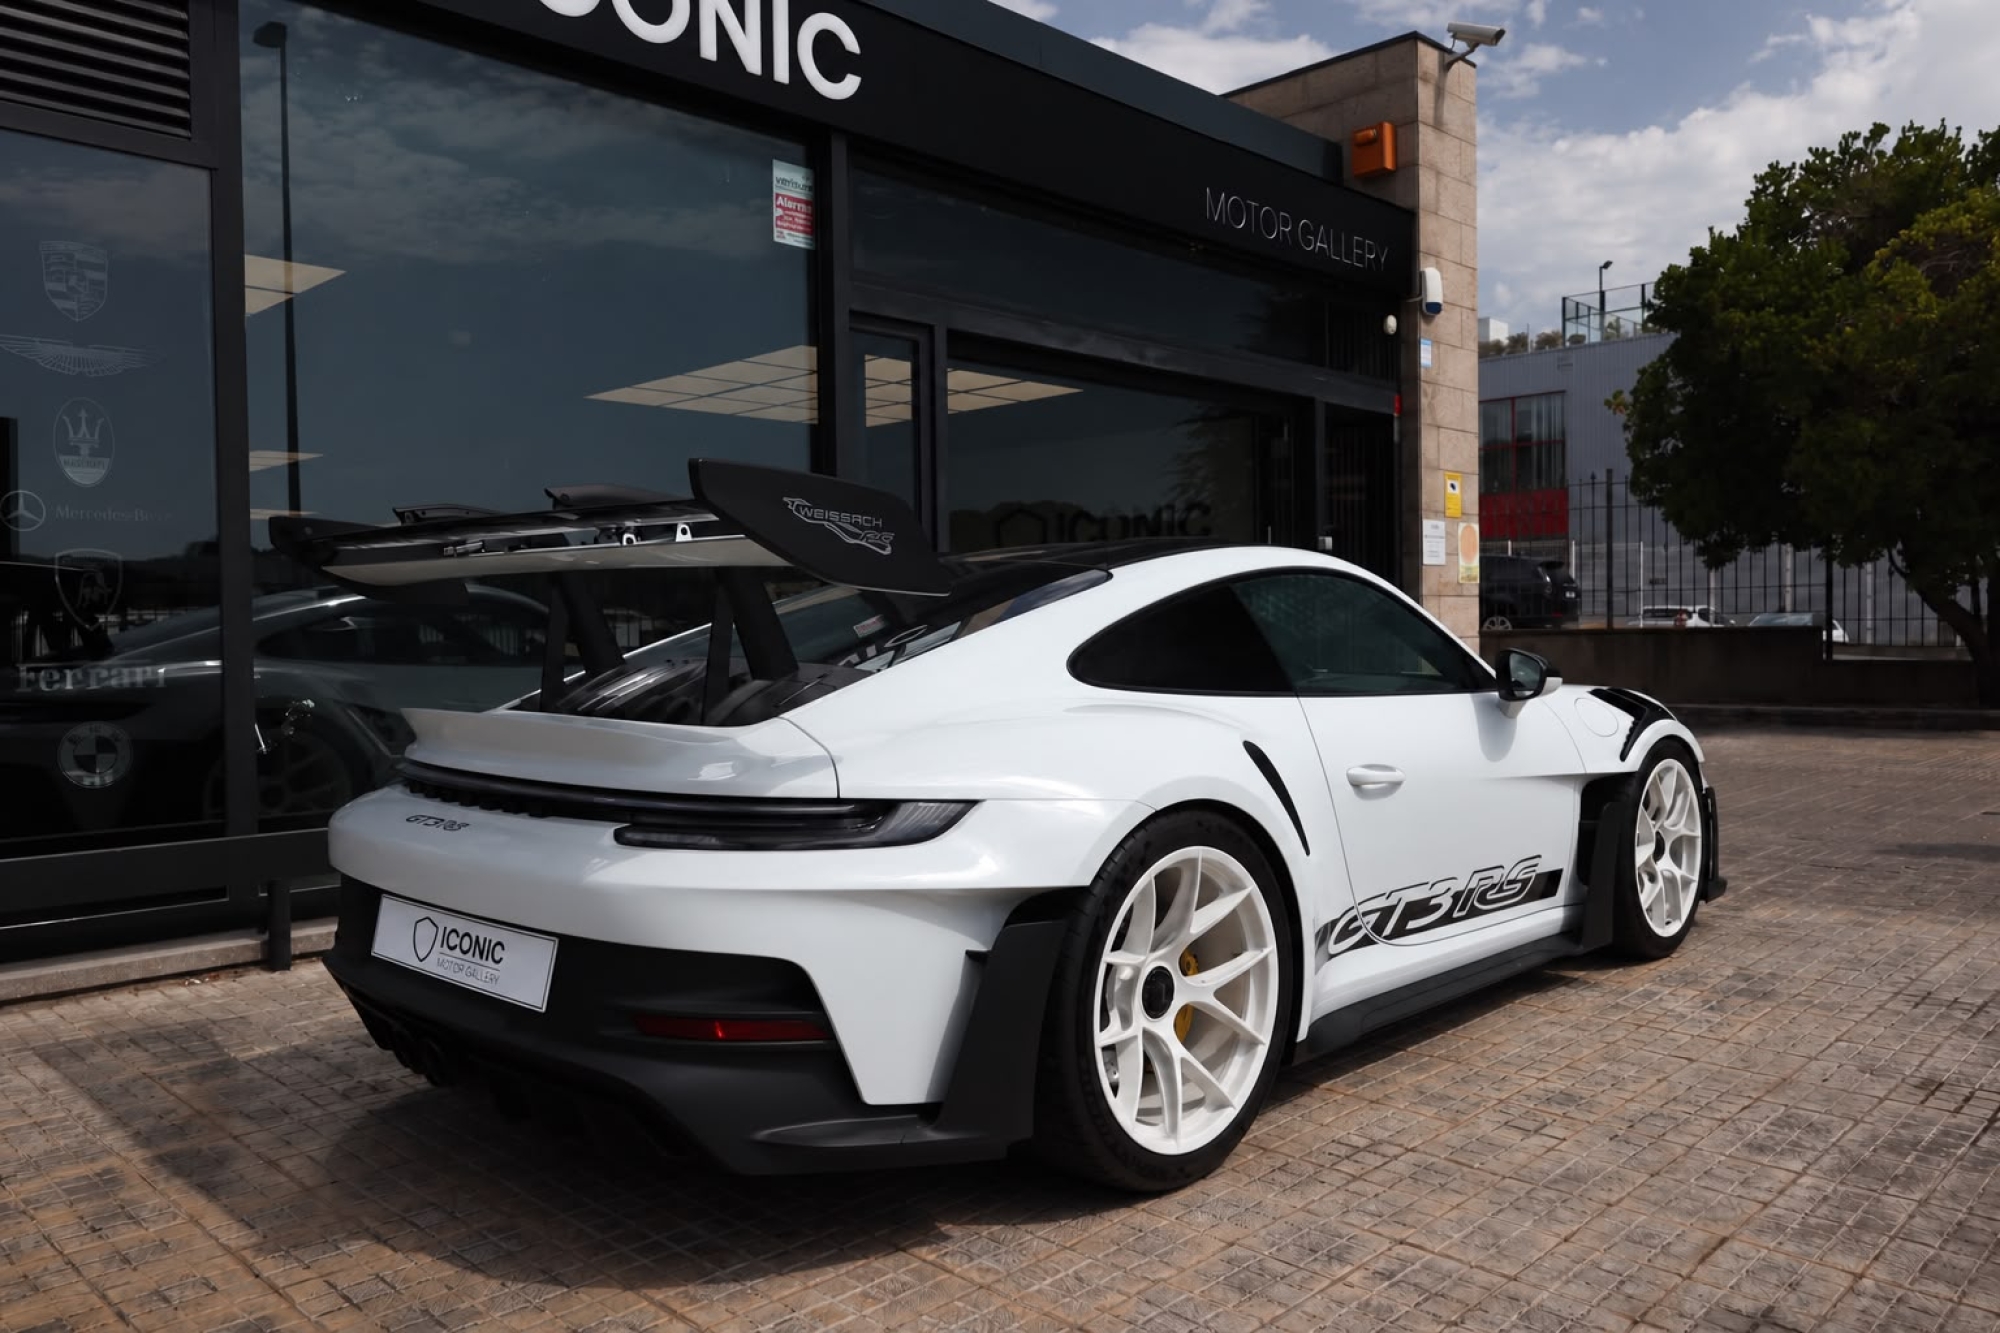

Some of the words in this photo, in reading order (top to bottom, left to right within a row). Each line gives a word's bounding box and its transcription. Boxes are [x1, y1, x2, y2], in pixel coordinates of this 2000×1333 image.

[1205, 186, 1292, 246] MOTOR
[1297, 218, 1390, 272] GALLERY
[798, 505, 883, 528] WEISSACH
[15, 661, 168, 692] Ferrari
[440, 926, 505, 965] ICONIC
[437, 956, 464, 974] MOTOR
[464, 966, 500, 986] GALLERY
